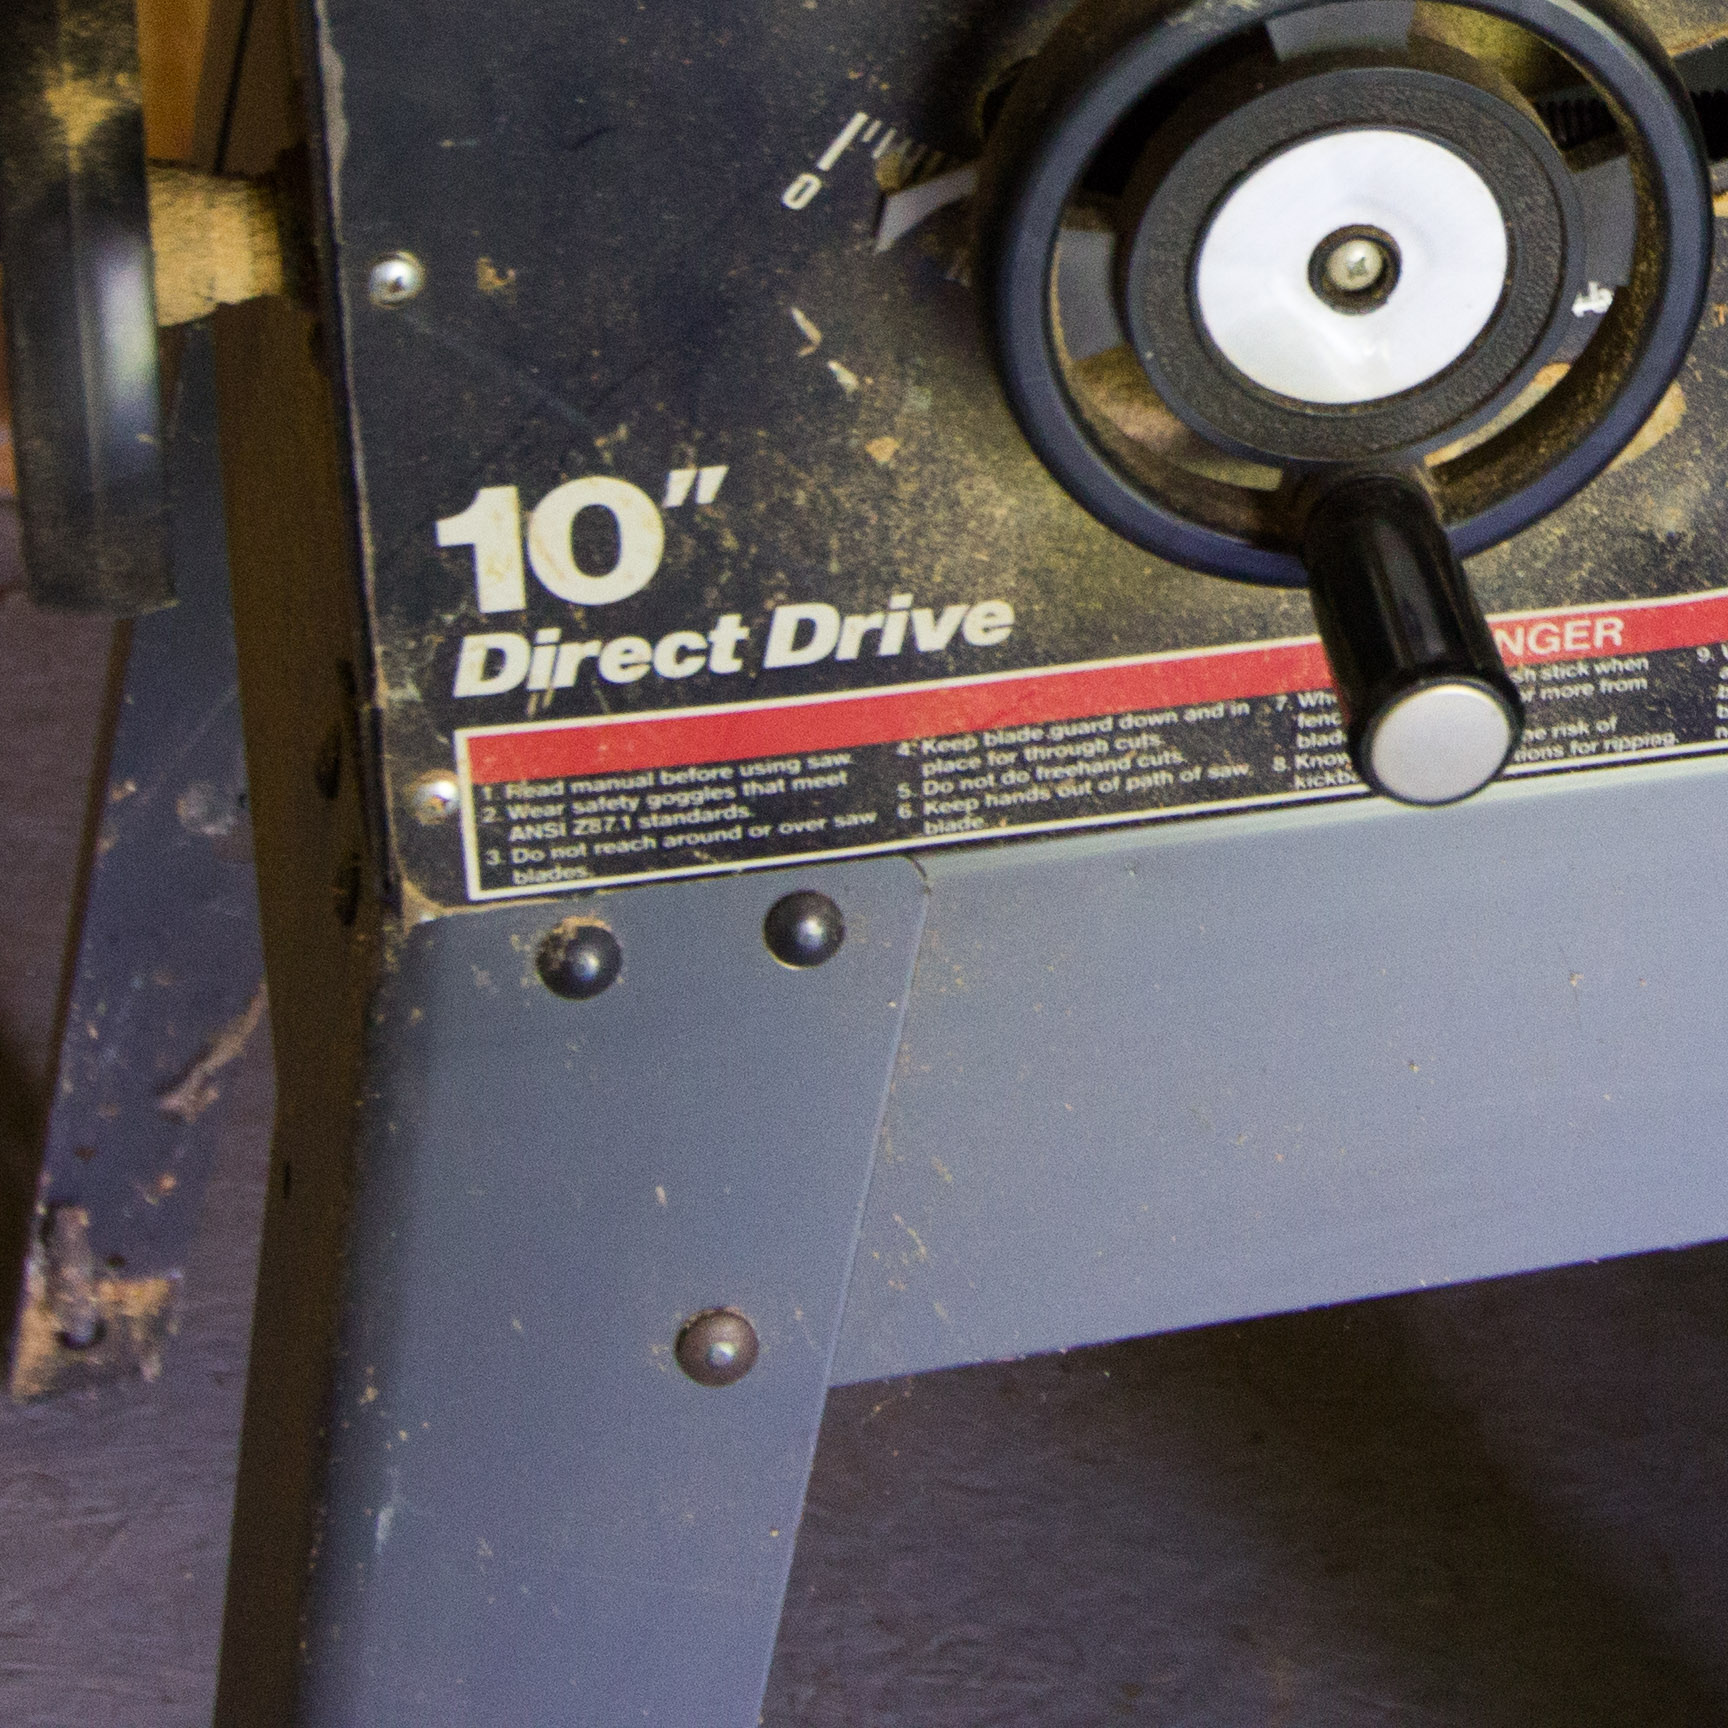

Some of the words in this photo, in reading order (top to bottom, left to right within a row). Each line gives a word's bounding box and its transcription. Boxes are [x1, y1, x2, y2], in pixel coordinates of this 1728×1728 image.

[436, 465, 728, 613] 10"
[453, 613, 750, 698] Direct
[763, 593, 1016, 669] Drive
[1495, 617, 1624, 657] NGER
[1297, 690, 1338, 708] Wh
[1541, 659, 1590, 681] stick
[1593, 656, 1649, 675] when
[1297, 711, 1342, 730] fenc
[1540, 682, 1595, 702] more
[1599, 676, 1648, 694] from
[921, 735, 979, 756] Keep
[983, 727, 1044, 749] blade
[1049, 716, 1113, 742] guard
[1119, 711, 1178, 731] down
[1183, 702, 1224, 723] and
[1230, 702, 1250, 719] in
[1550, 720, 1590, 739] risk
[1595, 713, 1617, 733] of
[1569, 739, 1599, 757] for
[505, 780, 564, 800] Read
[570, 771, 655, 793] manual
[661, 767, 733, 786] before
[740, 759, 801, 778] using
[922, 755, 981, 779] place
[987, 749, 1018, 767] for
[1023, 737, 1108, 762] through
[922, 779, 955, 797] Do
[959, 772, 995, 792] not
[1000, 768, 1030, 786] do
[1036, 757, 1131, 782] freehand
[506, 802, 564, 821] Wear
[572, 793, 640, 815] safety
[646, 786, 736, 811] goggles
[742, 778, 785, 797] that
[791, 770, 848, 792] meet
[923, 797, 979, 817] Keep
[984, 785, 1051, 808] hands
[1055, 779, 1092, 799] out
[1098, 775, 1119, 793] of
[1126, 770, 1174, 793] path
[1180, 765, 1201, 783] of
[509, 821, 567, 842] ANSI
[511, 847, 546, 865] Do
[550, 842, 588, 860] not
[593, 834, 657, 857] reach
[662, 824, 742, 849] around
[748, 824, 771, 840] or
[778, 818, 828, 835] over
[834, 812, 877, 829] saw
